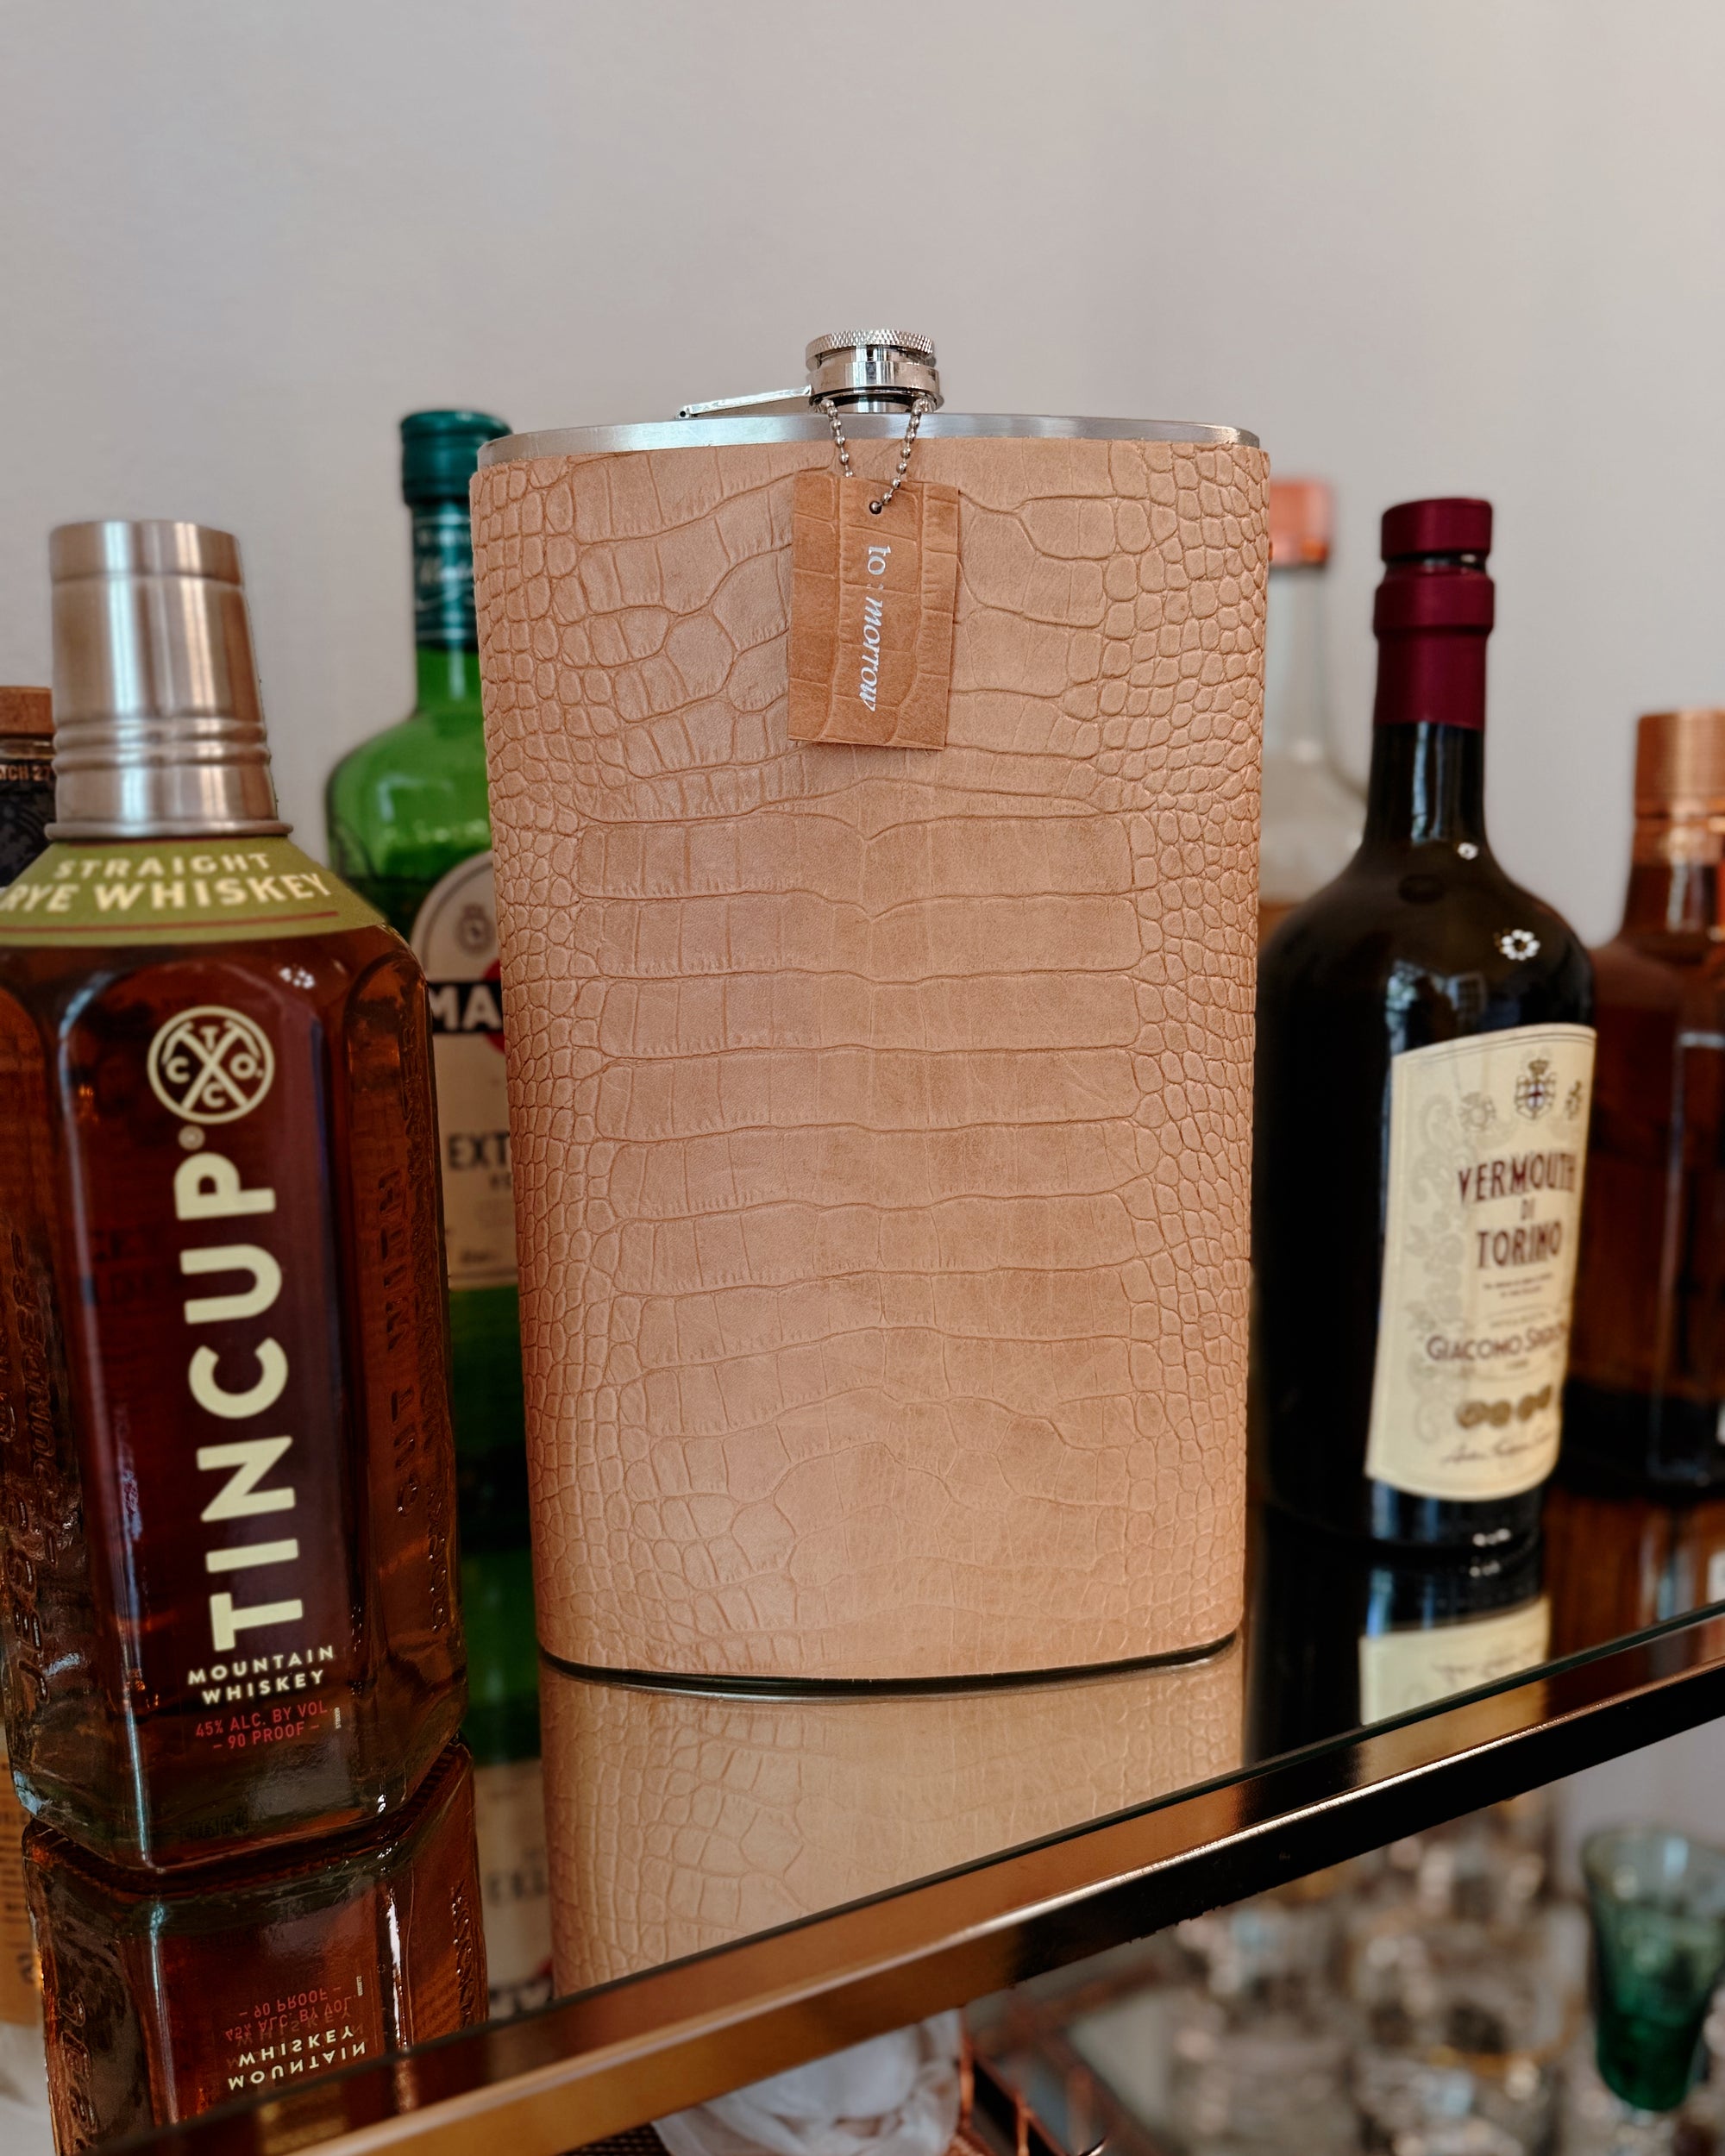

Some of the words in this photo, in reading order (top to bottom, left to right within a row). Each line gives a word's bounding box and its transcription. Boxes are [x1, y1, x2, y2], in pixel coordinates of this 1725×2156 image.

[867, 545, 892, 575] to
[859, 597, 883, 711] morrow
[53, 853, 271, 880] STRAIGHT
[0, 884, 79, 913] RYE
[93, 873, 332, 912] WHISKEY
[448, 1131, 511, 1170] EXT
[1476, 1220, 1562, 1269] TORINO
[174, 1151, 304, 1651] TINCUP
[187, 1645, 335, 1685] MOUNTAIN
[202, 1670, 324, 1705] WHISKEY
[196, 1719, 224, 1738] 45%
[230, 1712, 267, 1733] ALC.
[273, 1706, 292, 1724] BY
[228, 1733, 247, 1750] 90
[253, 1721, 305, 1745] PROOF
